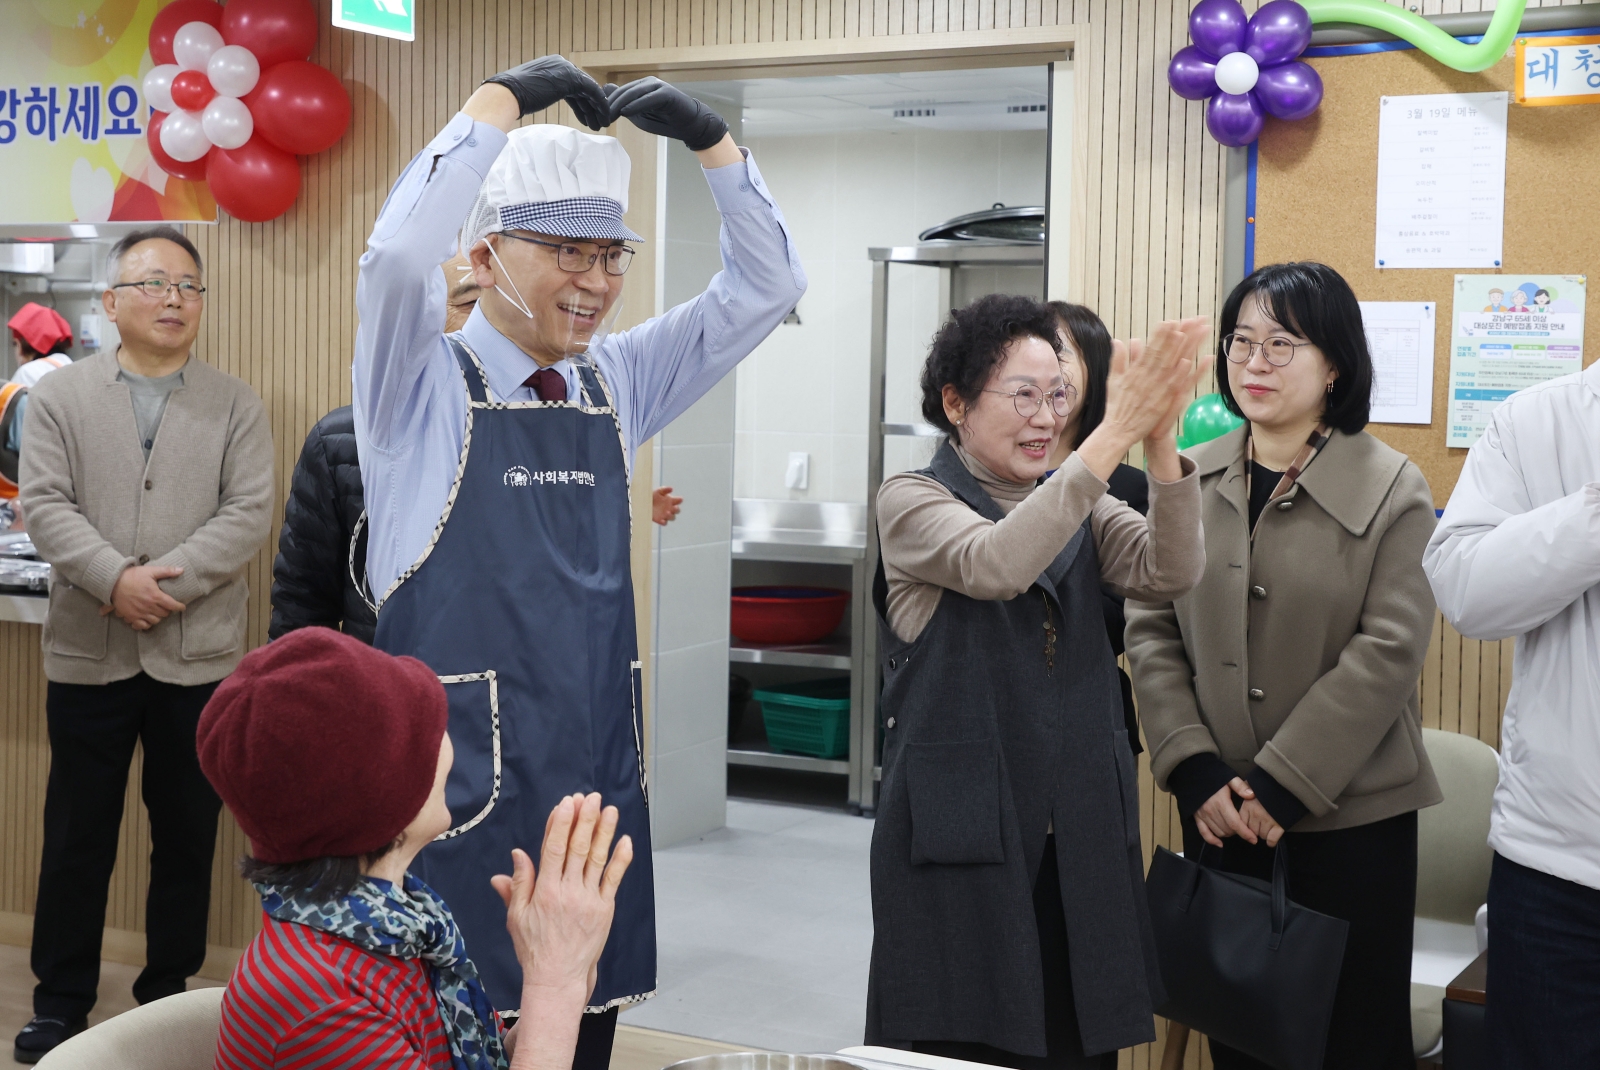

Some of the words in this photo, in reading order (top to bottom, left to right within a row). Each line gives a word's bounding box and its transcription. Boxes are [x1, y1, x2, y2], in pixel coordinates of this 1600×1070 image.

[0, 85, 155, 144] 강하세요
[1407, 108, 1423, 119] 3월
[1429, 107, 1451, 118] 19일
[1457, 106, 1478, 117] 메뉴
[1532, 315, 1547, 323] 이상
[1473, 322, 1502, 330] 대상포진
[1503, 322, 1532, 330] 예방접종
[1534, 322, 1549, 330] 지원
[1550, 322, 1566, 331] 안내
